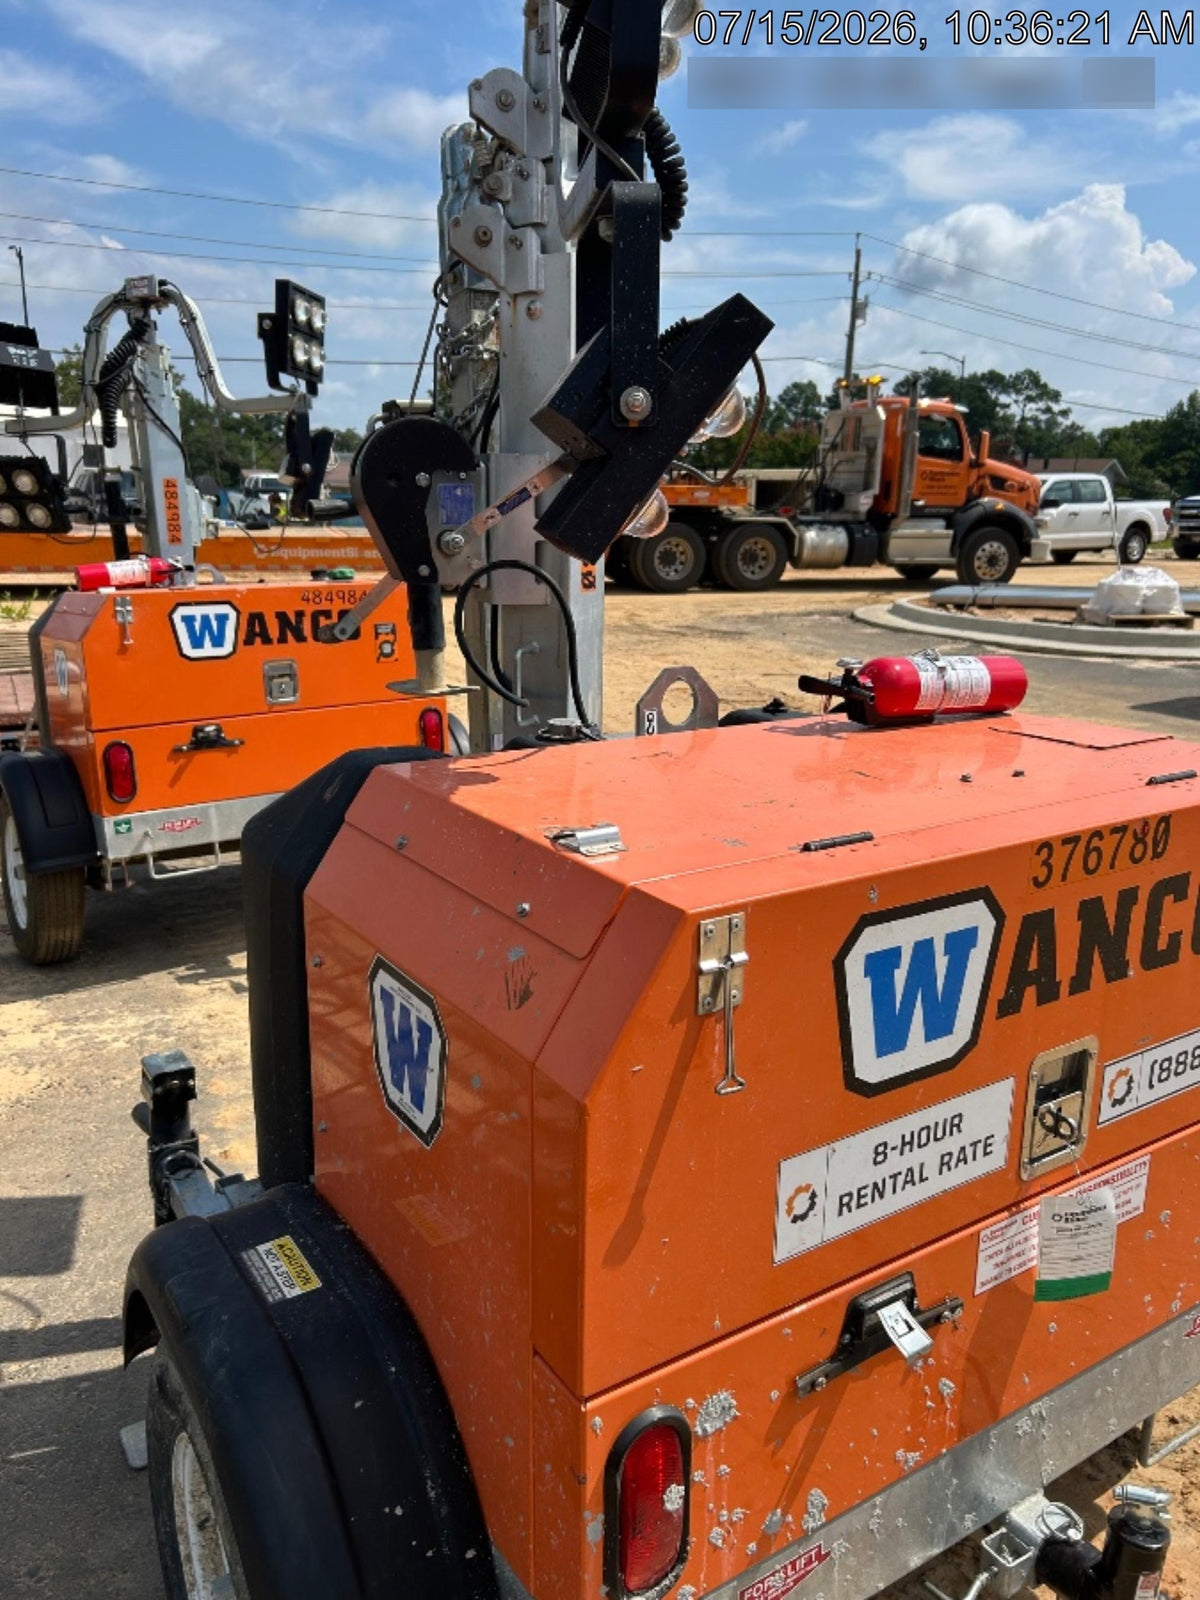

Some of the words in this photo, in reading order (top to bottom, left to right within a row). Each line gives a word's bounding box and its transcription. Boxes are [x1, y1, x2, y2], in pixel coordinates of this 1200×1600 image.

[864, 871, 1200, 1058] WANC
[380, 984, 433, 1115] W
[1148, 1045, 1200, 1090] (888
[837, 1161, 930, 1218] RENTAL
[938, 1133, 996, 1177] RATE
[872, 1112, 964, 1167] 8-HOUR
